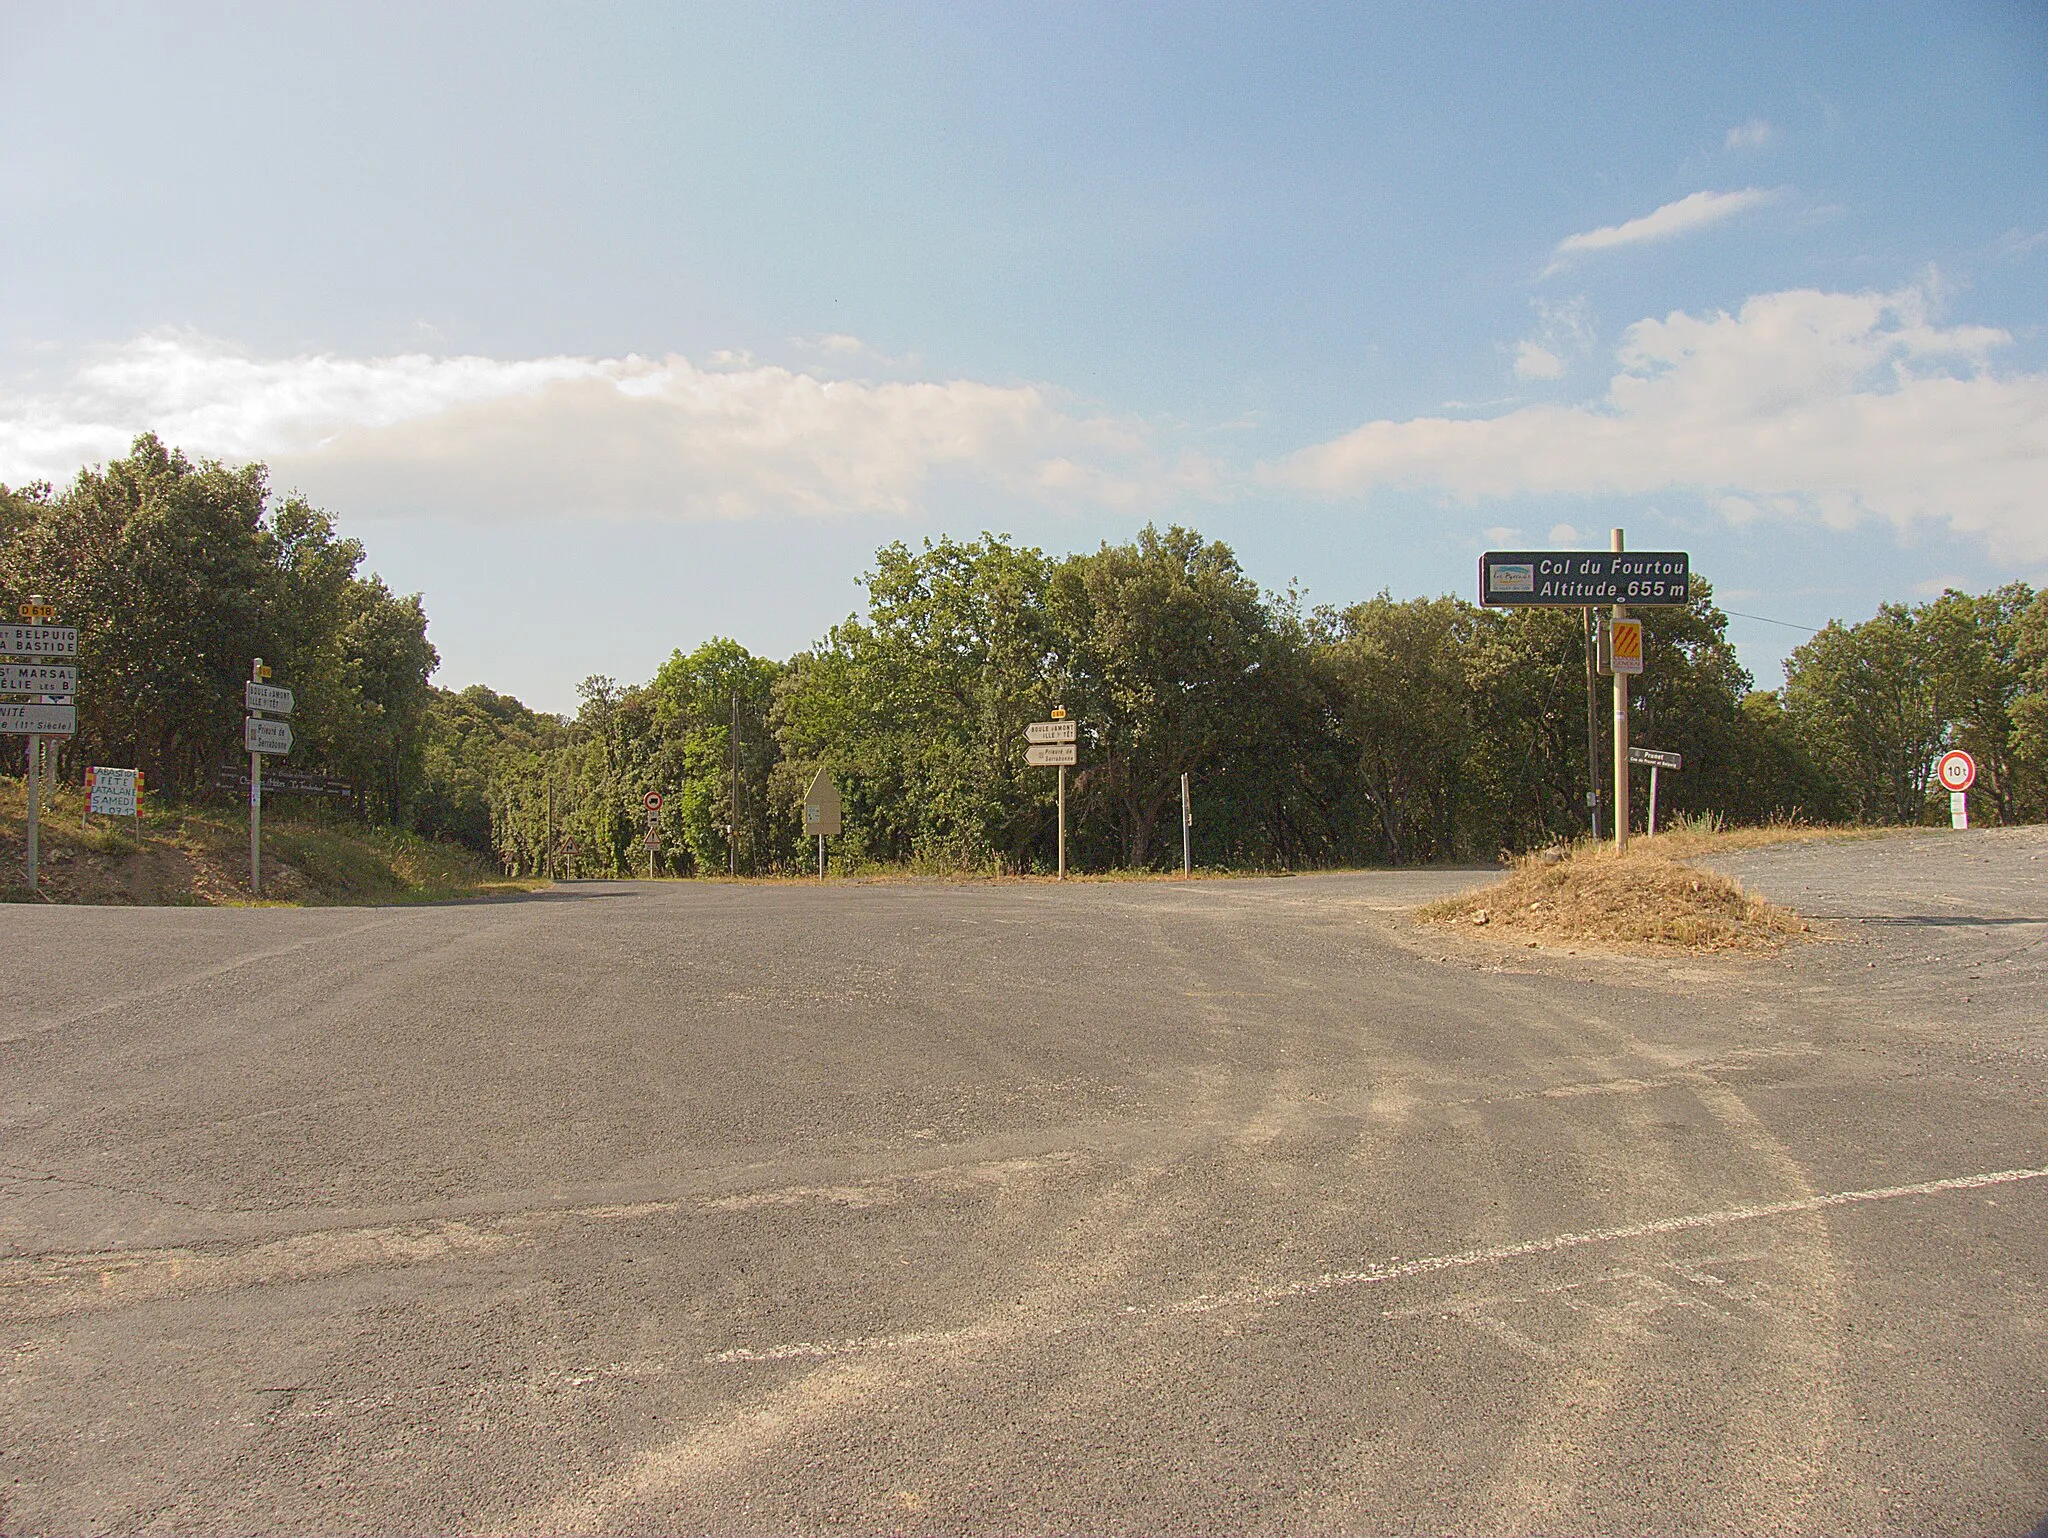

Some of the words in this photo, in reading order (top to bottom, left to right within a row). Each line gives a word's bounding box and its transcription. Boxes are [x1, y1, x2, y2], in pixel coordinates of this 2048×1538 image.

[1539, 559, 1571, 575] Col
[1579, 559, 1601, 575] du
[1610, 558, 1684, 575] Fourtou
[1540, 581, 1617, 597] Altitude
[1627, 581, 1665, 597] 655
[1669, 586, 1684, 596] m
[21, 606, 29, 615] D
[32, 606, 52, 616] 618
[16, 629, 75, 640] BELPUIG
[0, 641, 7, 650] A
[16, 641, 75, 652] BASTIDE
[19, 668, 74, 679] MARSAL
[1, 679, 32, 689] ÉLIE
[62, 681, 74, 691] B.
[0, 705, 26, 717] NITÉ
[93, 769, 137, 779] LABASTIDE
[1948, 766, 1961, 777] 10
[91, 786, 136, 797] CATALANE
[93, 796, 134, 806] SAMEDI
